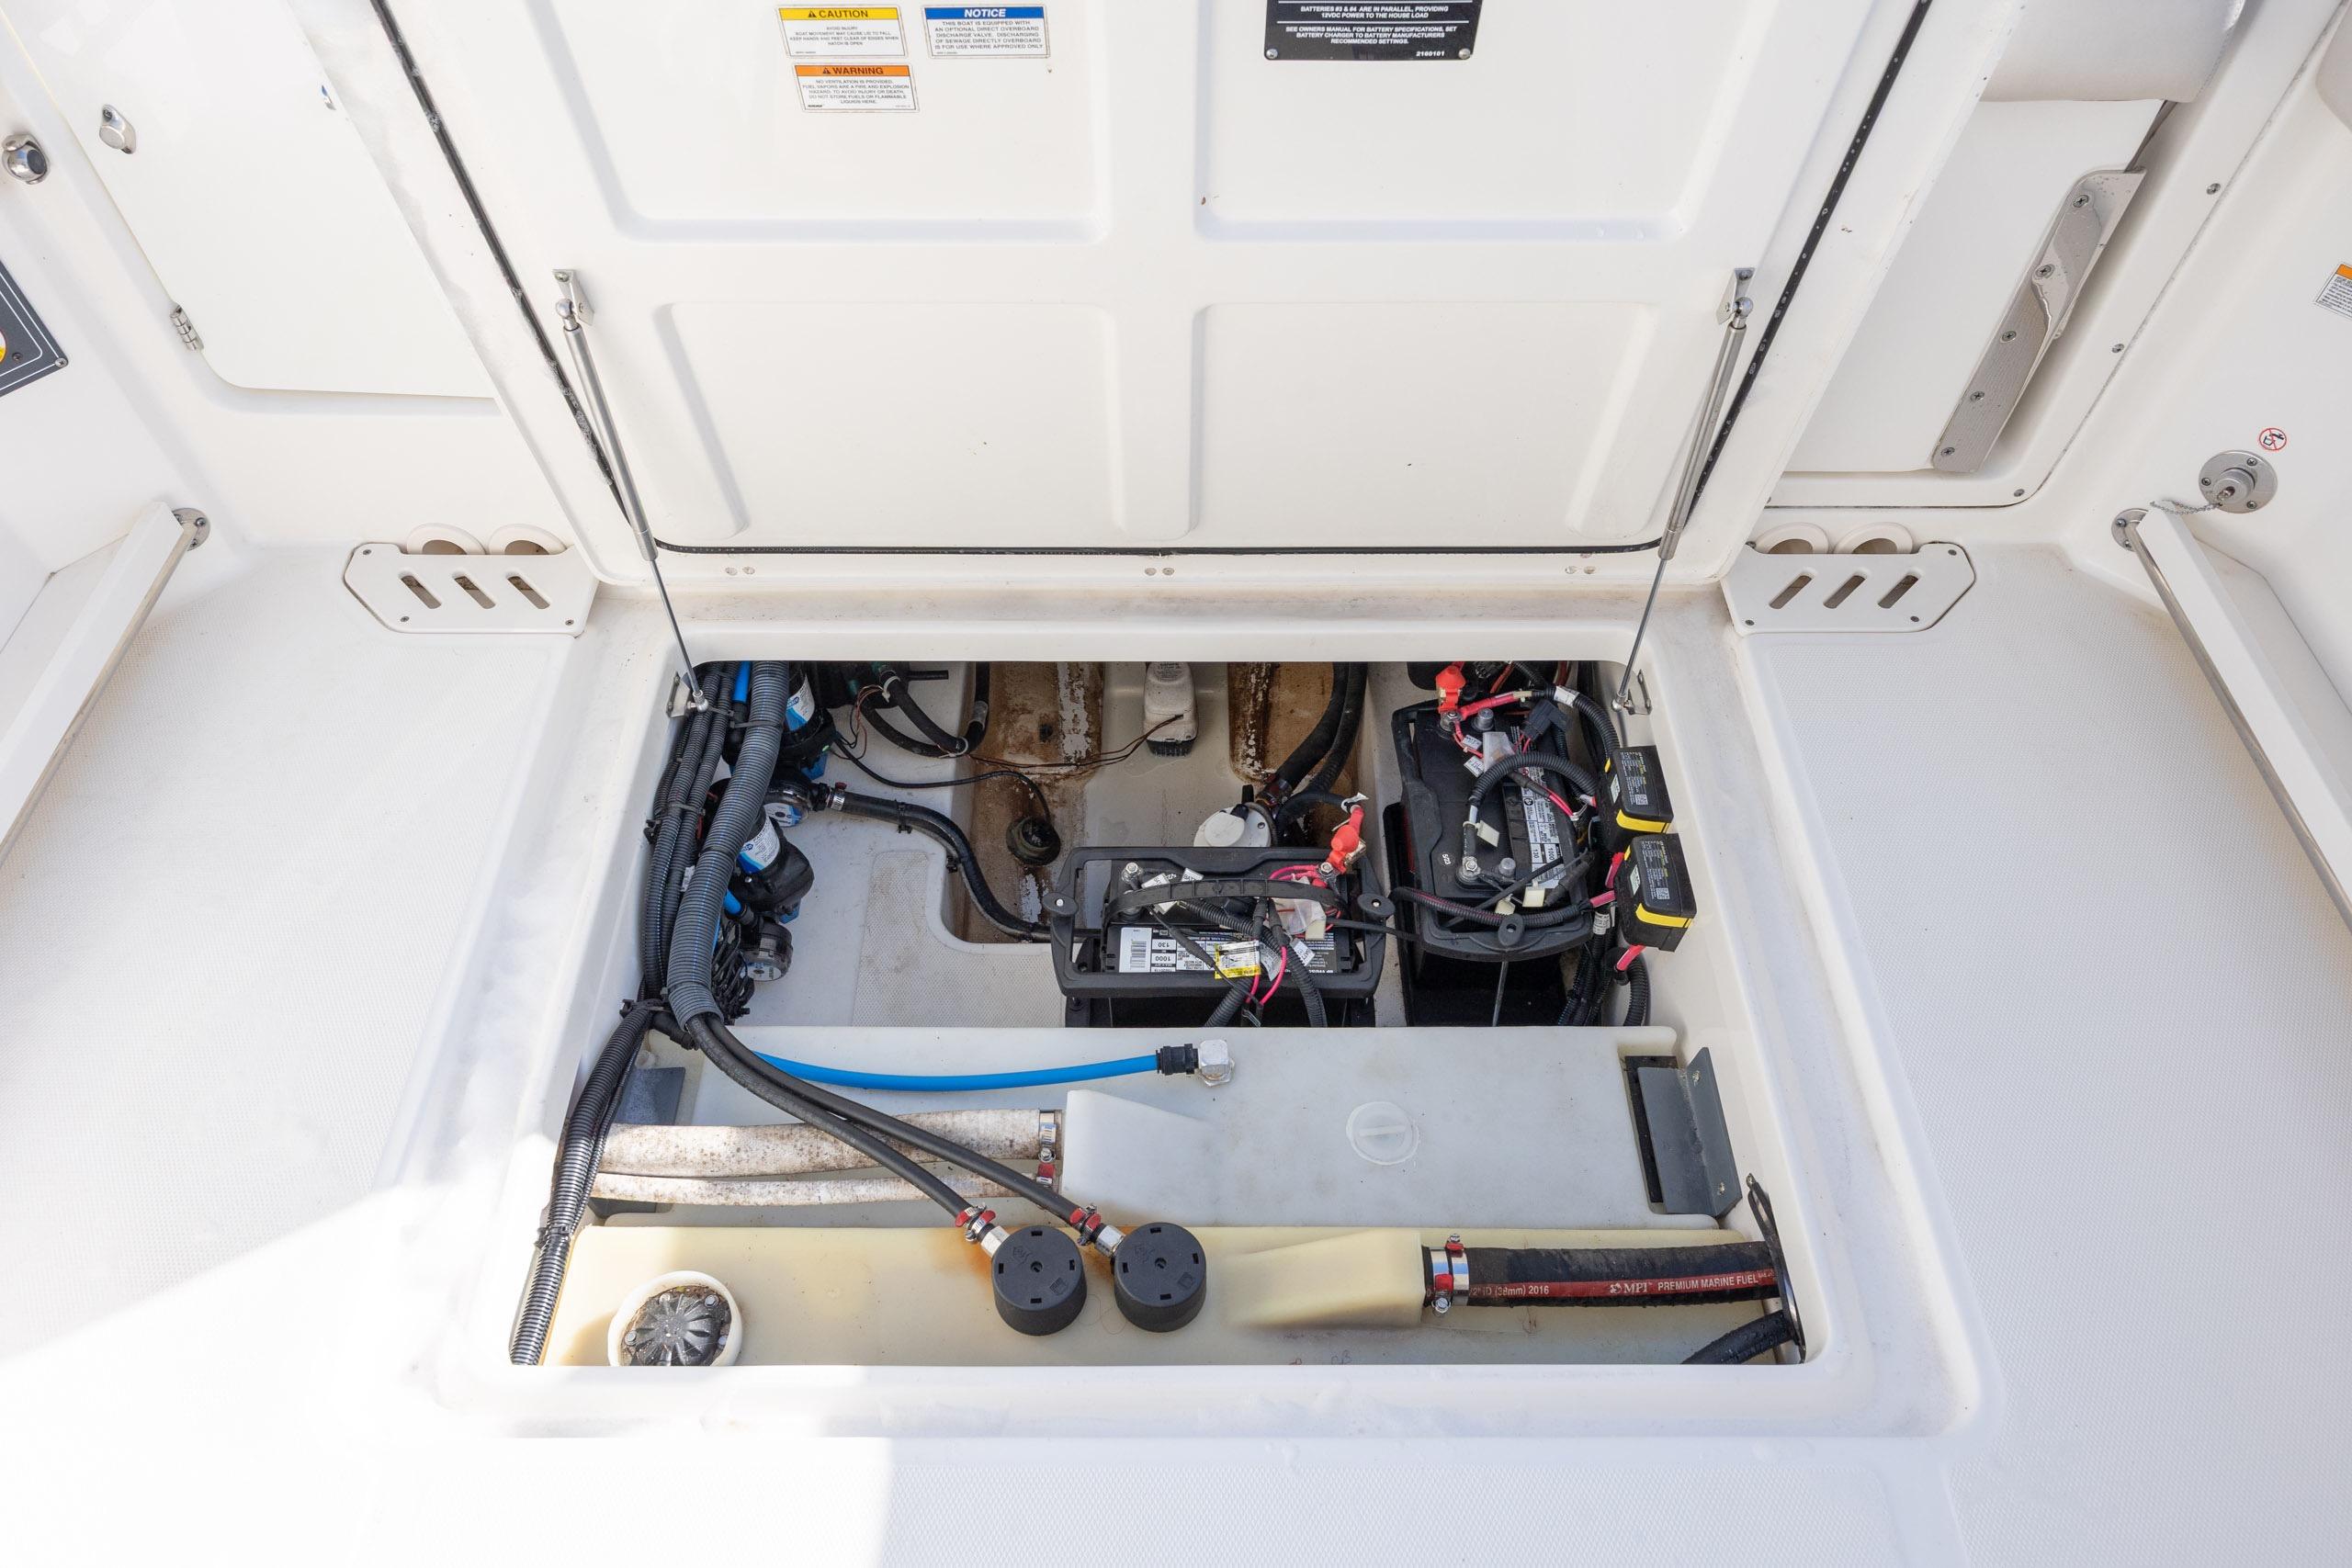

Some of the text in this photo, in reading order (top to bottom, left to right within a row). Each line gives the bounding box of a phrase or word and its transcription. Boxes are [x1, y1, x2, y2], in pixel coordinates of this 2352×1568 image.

[964, 9, 1006, 17] NOTICE
[1624, 1283, 1648, 1293] MPI
[1658, 1280, 1698, 1291] PREMIUM
[1701, 1277, 1734, 1288] MARINE
[1737, 1275, 1758, 1284] FUEL
[1528, 1286, 1549, 1294] 2016
